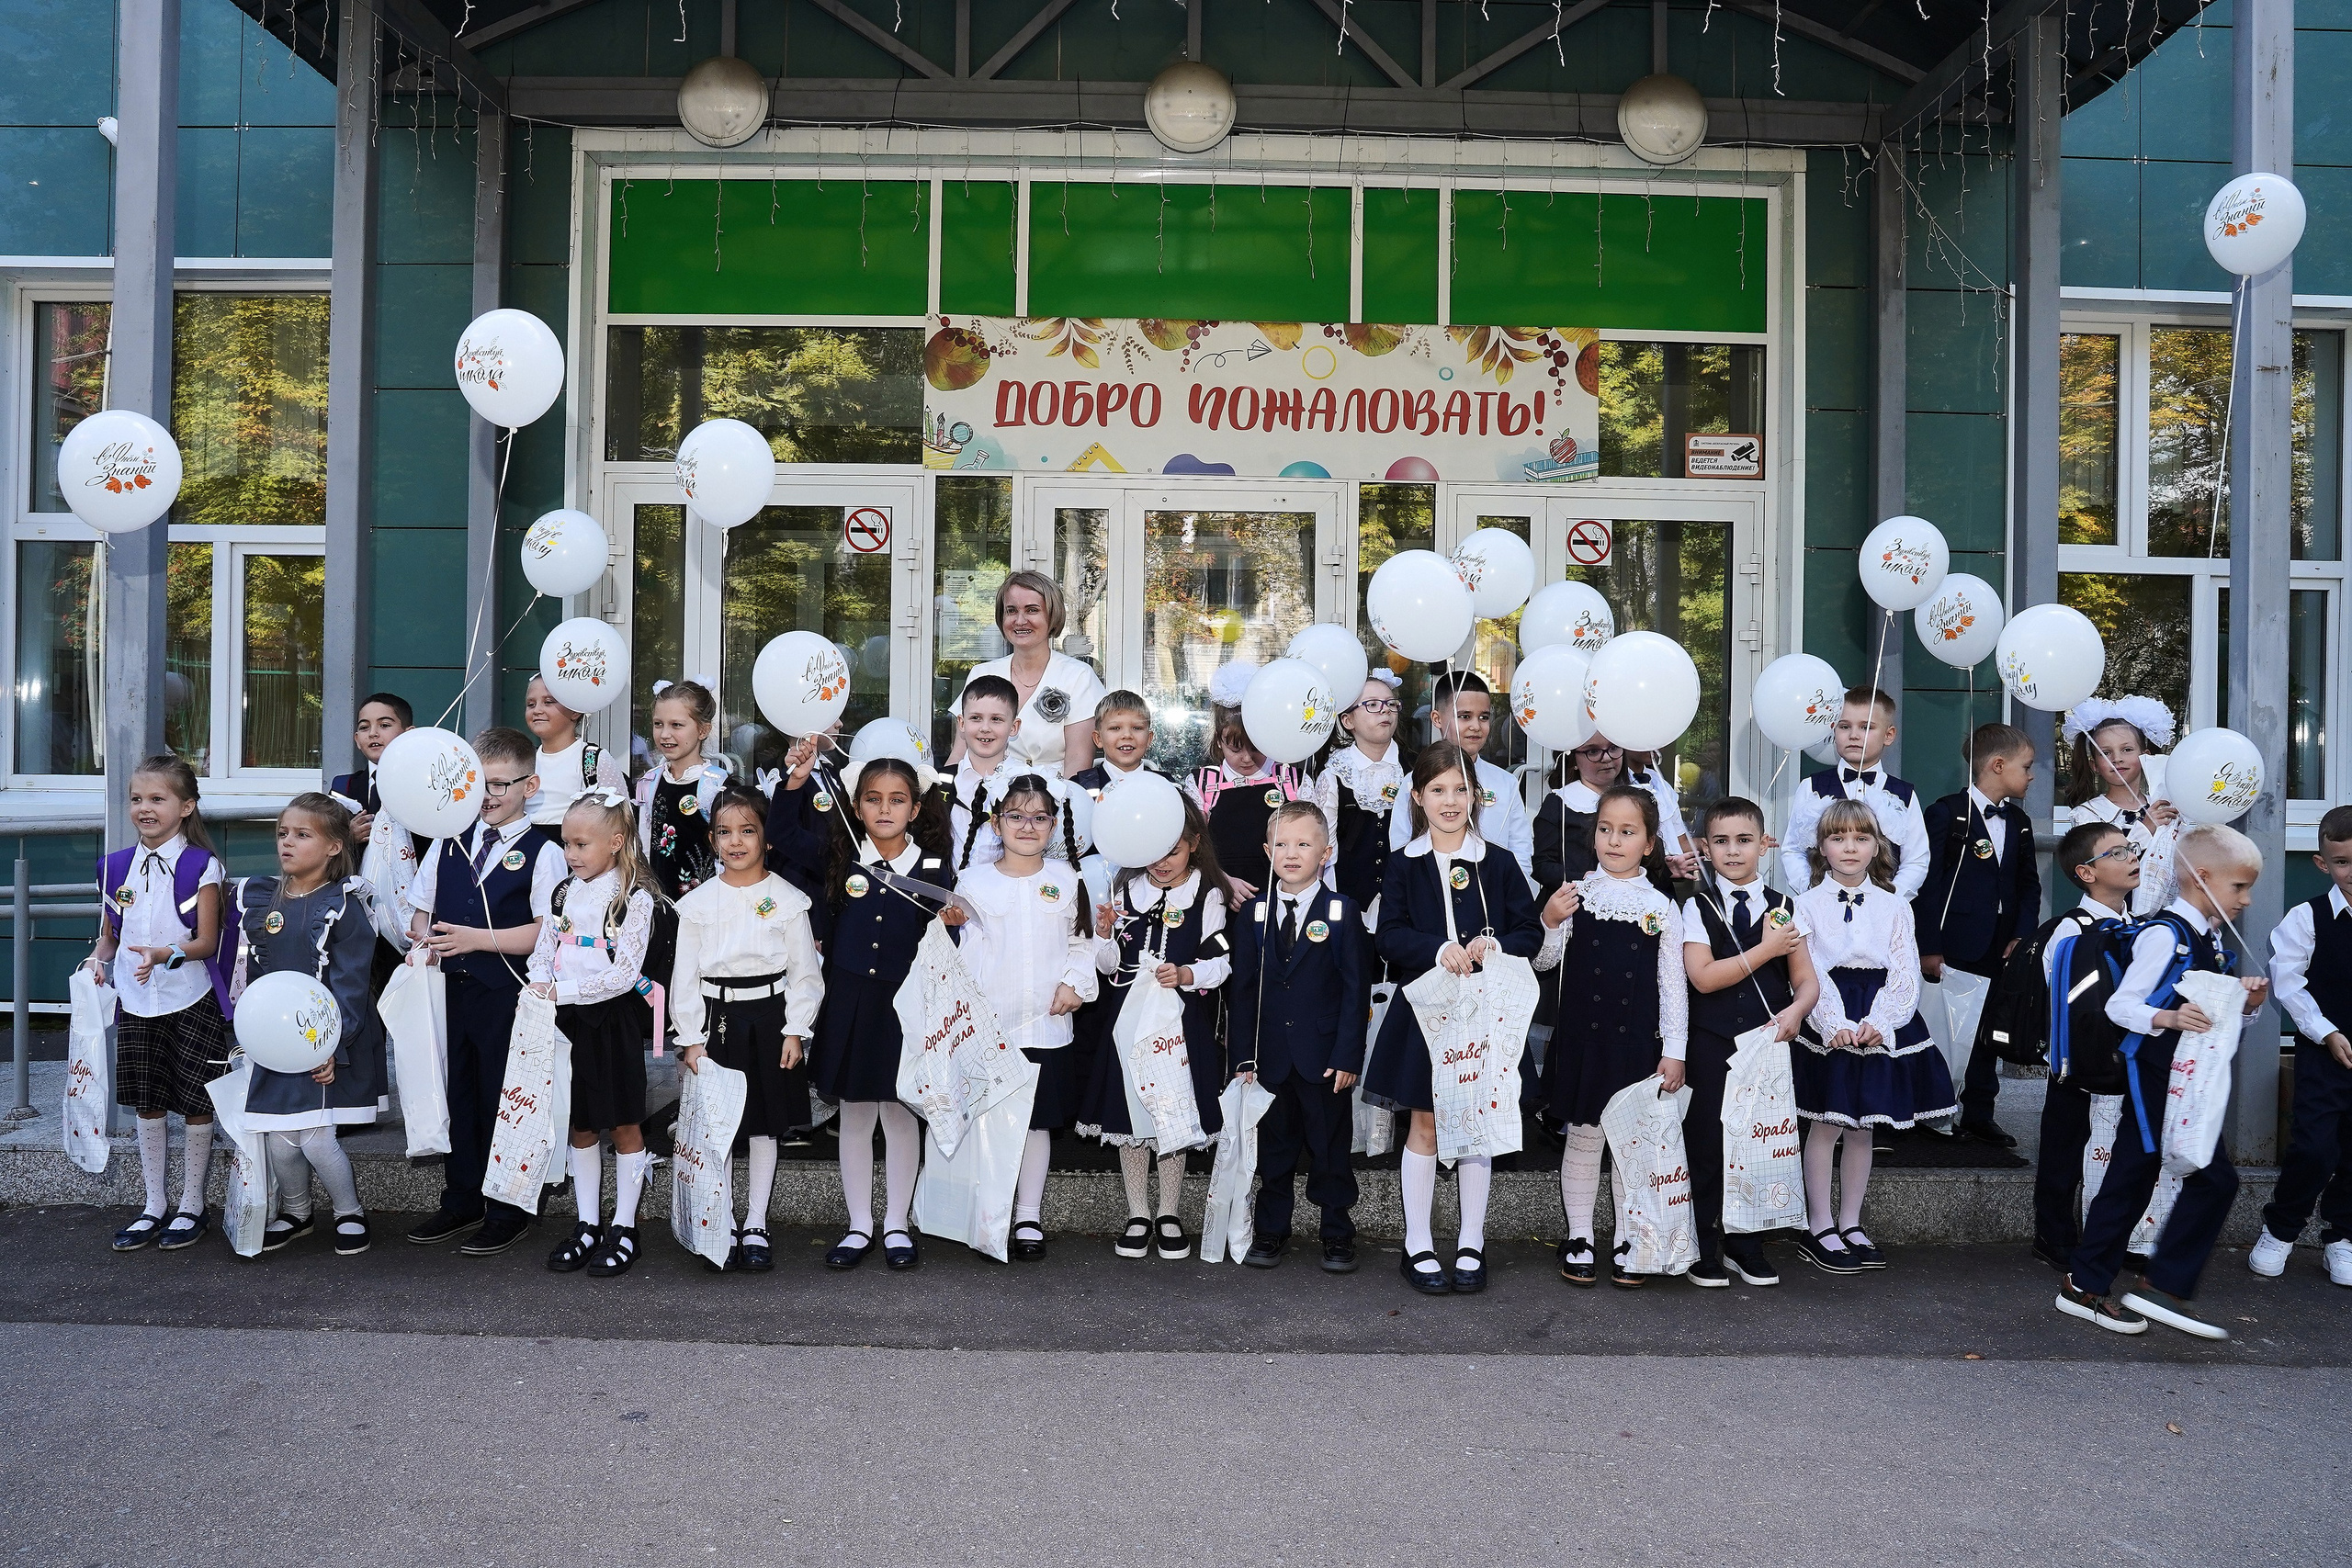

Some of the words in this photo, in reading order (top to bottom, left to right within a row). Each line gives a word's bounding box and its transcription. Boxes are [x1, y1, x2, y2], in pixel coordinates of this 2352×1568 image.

[459, 367, 505, 385] школа
[993, 379, 1162, 428] ДОБРО
[1188, 382, 1545, 436] ПОЖАЛОВАТЬ!
[85, 461, 157, 487] Знаний
[1880, 560, 1928, 577] школа
[1933, 600, 1973, 646] Знаний
[557, 665, 607, 682] школа
